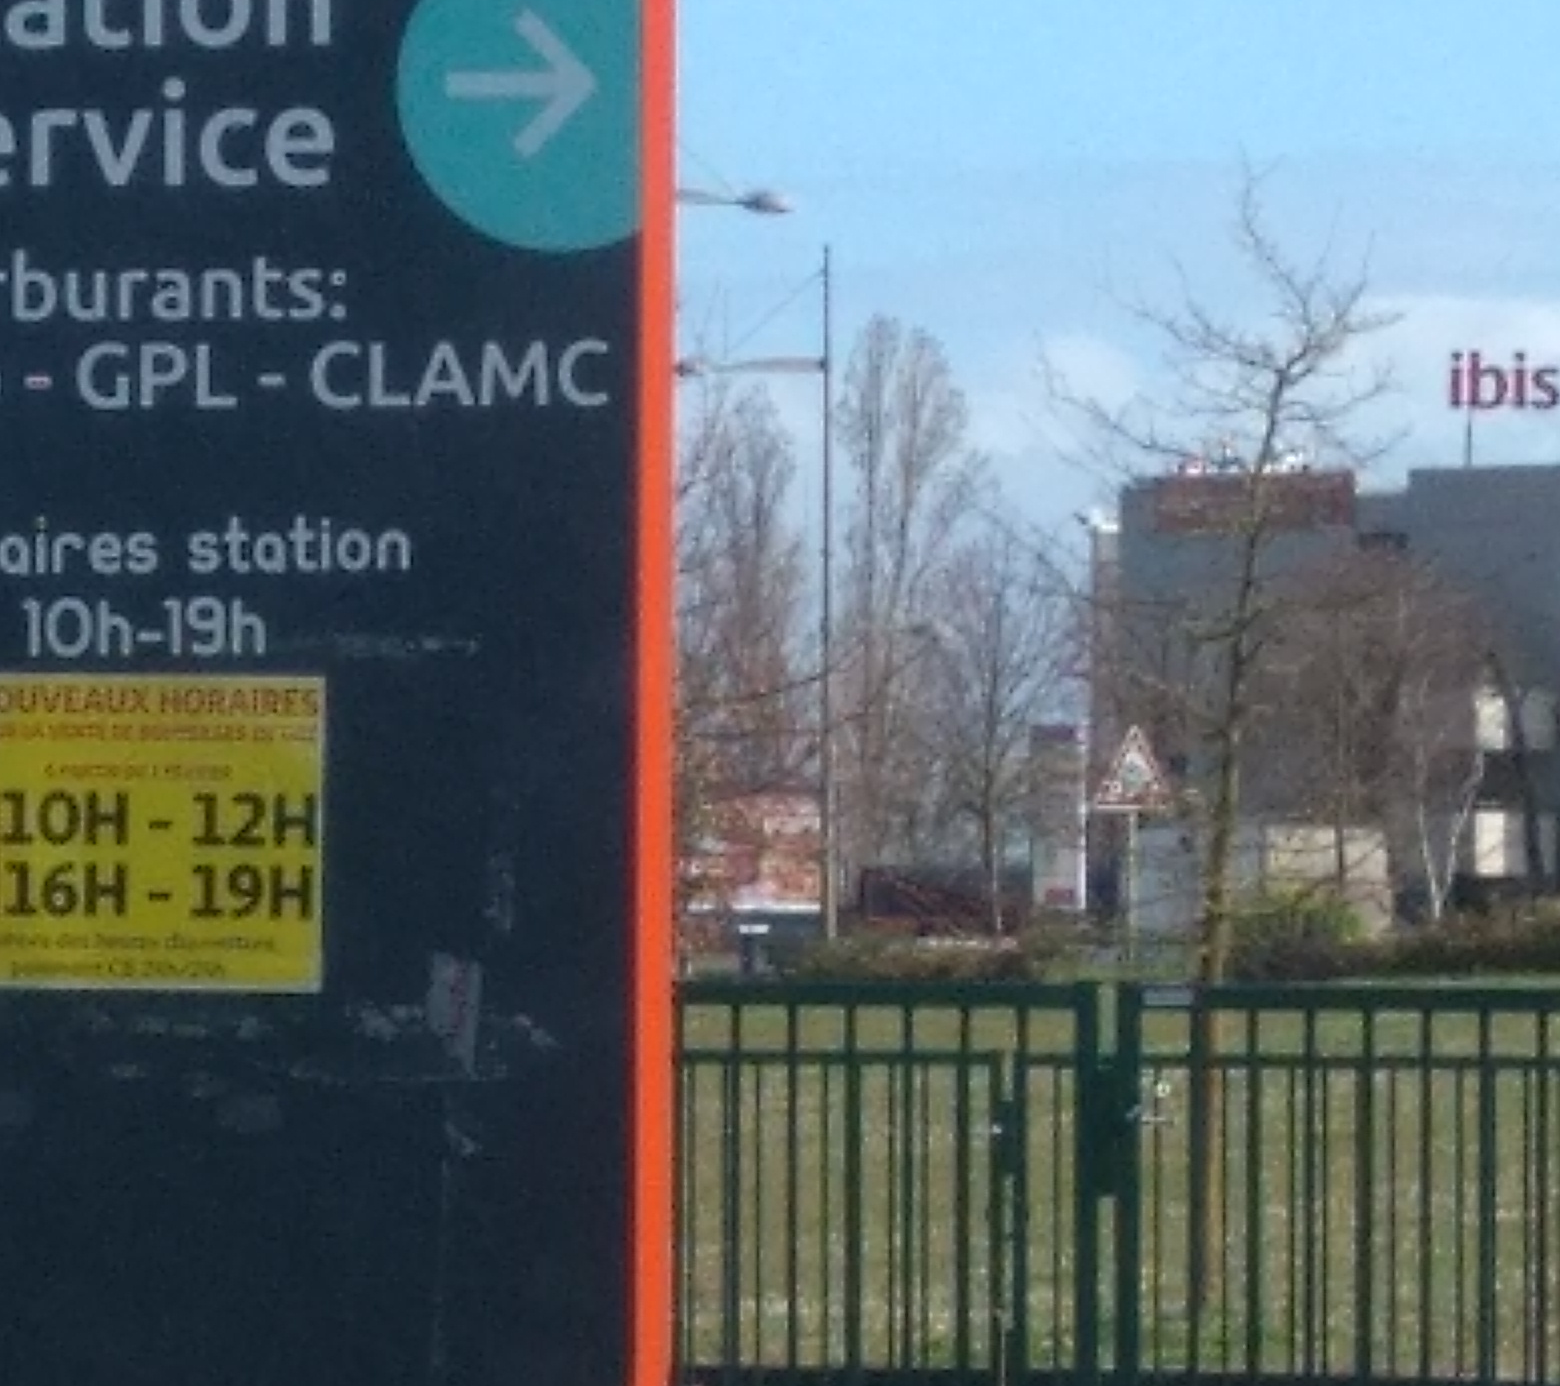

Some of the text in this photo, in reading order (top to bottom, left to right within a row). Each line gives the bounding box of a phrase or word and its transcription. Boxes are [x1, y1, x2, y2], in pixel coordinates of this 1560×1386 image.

[26, 375, 51, 388] -
[77, 345, 237, 410] GPL
[259, 373, 286, 386] -
[310, 341, 610, 407] CLAMC
[1450, 351, 1559, 411] ibis
[187, 517, 412, 573] station
[22, 596, 266, 657] 10h-19h
[161, 688, 318, 715] HORAIRES
[191, 791, 316, 848] 12H
[5, 861, 129, 917] 16H
[190, 863, 314, 920] 19H
